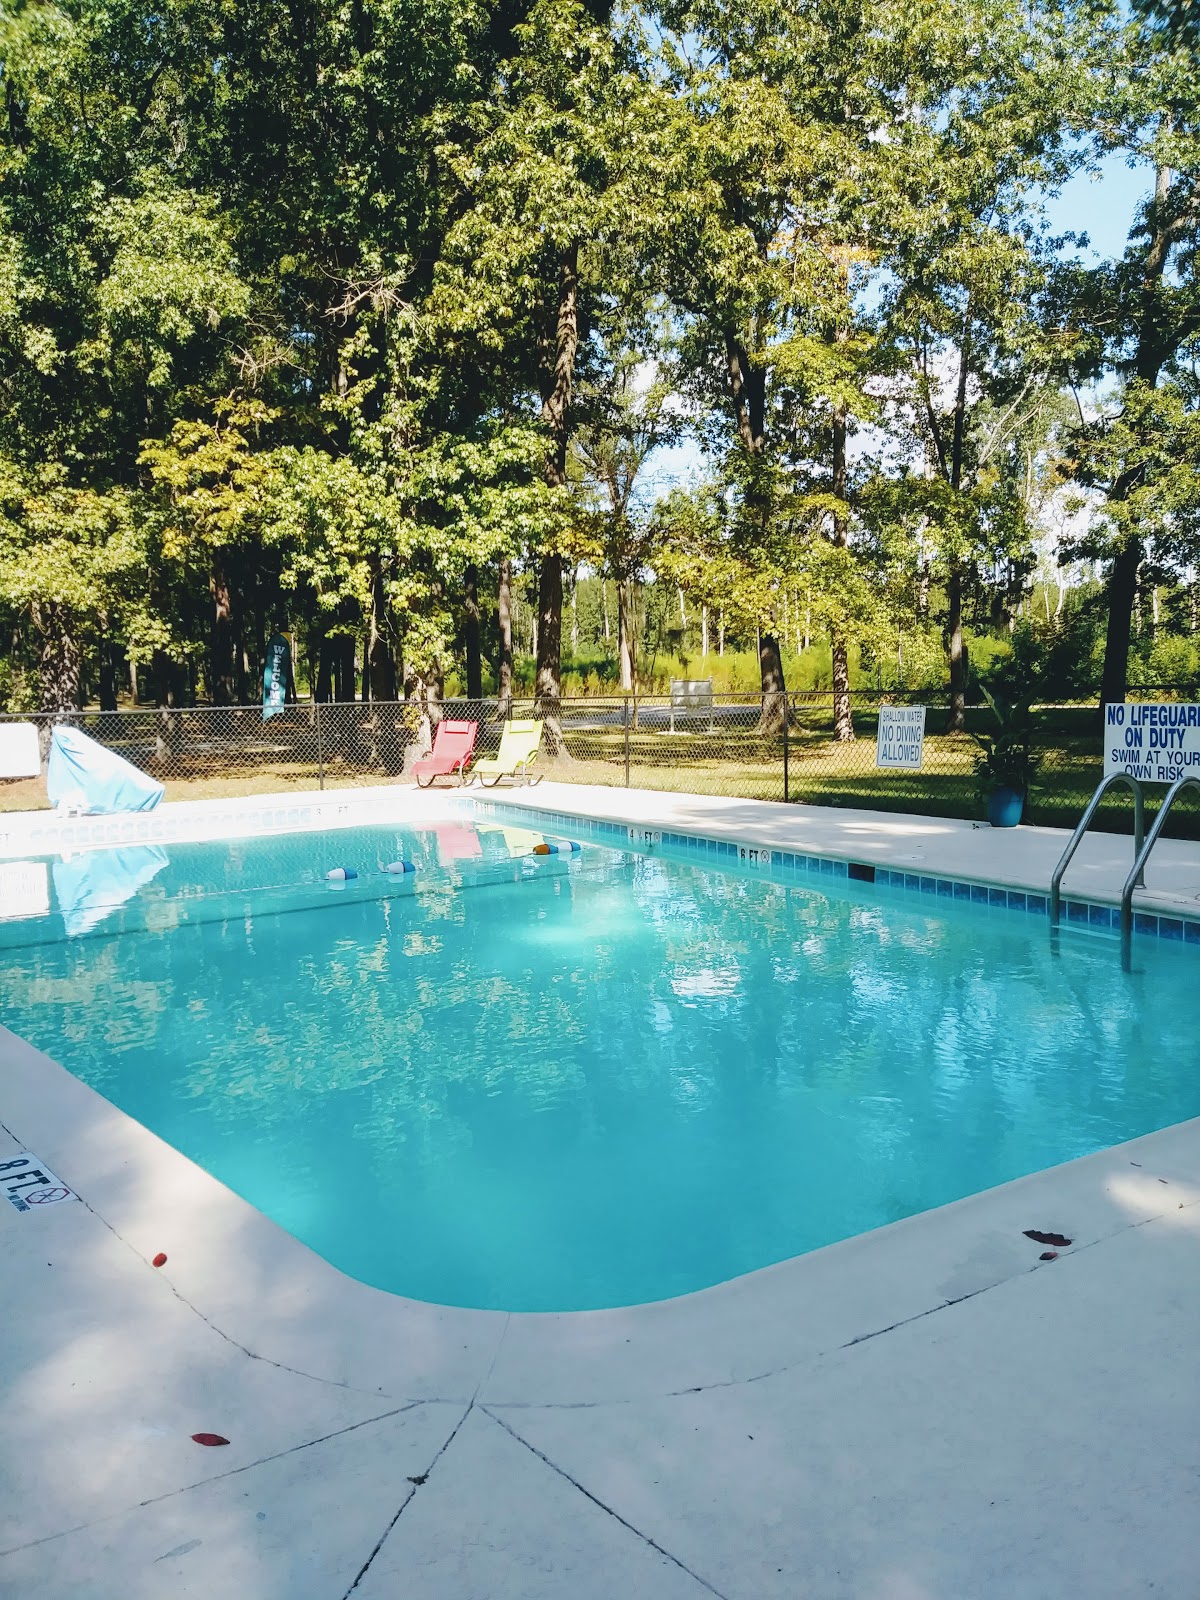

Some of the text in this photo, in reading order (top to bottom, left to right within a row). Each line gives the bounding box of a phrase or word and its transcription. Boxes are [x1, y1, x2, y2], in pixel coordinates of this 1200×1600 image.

[883, 711, 922, 722] SHALLOW WATER
[1108, 706, 1200, 727] NO LIFEGUAR
[882, 726, 922, 742] NO DIVING
[1125, 727, 1186, 748] ON DUTY
[882, 744, 919, 761] ALLOWED
[1111, 749, 1200, 766] SWIM AT YOUR
[1125, 764, 1185, 780] OWN RISK
[644, 831, 653, 842] FT
[749, 849, 759, 862] FT
[0, 1159, 30, 1171] 8
